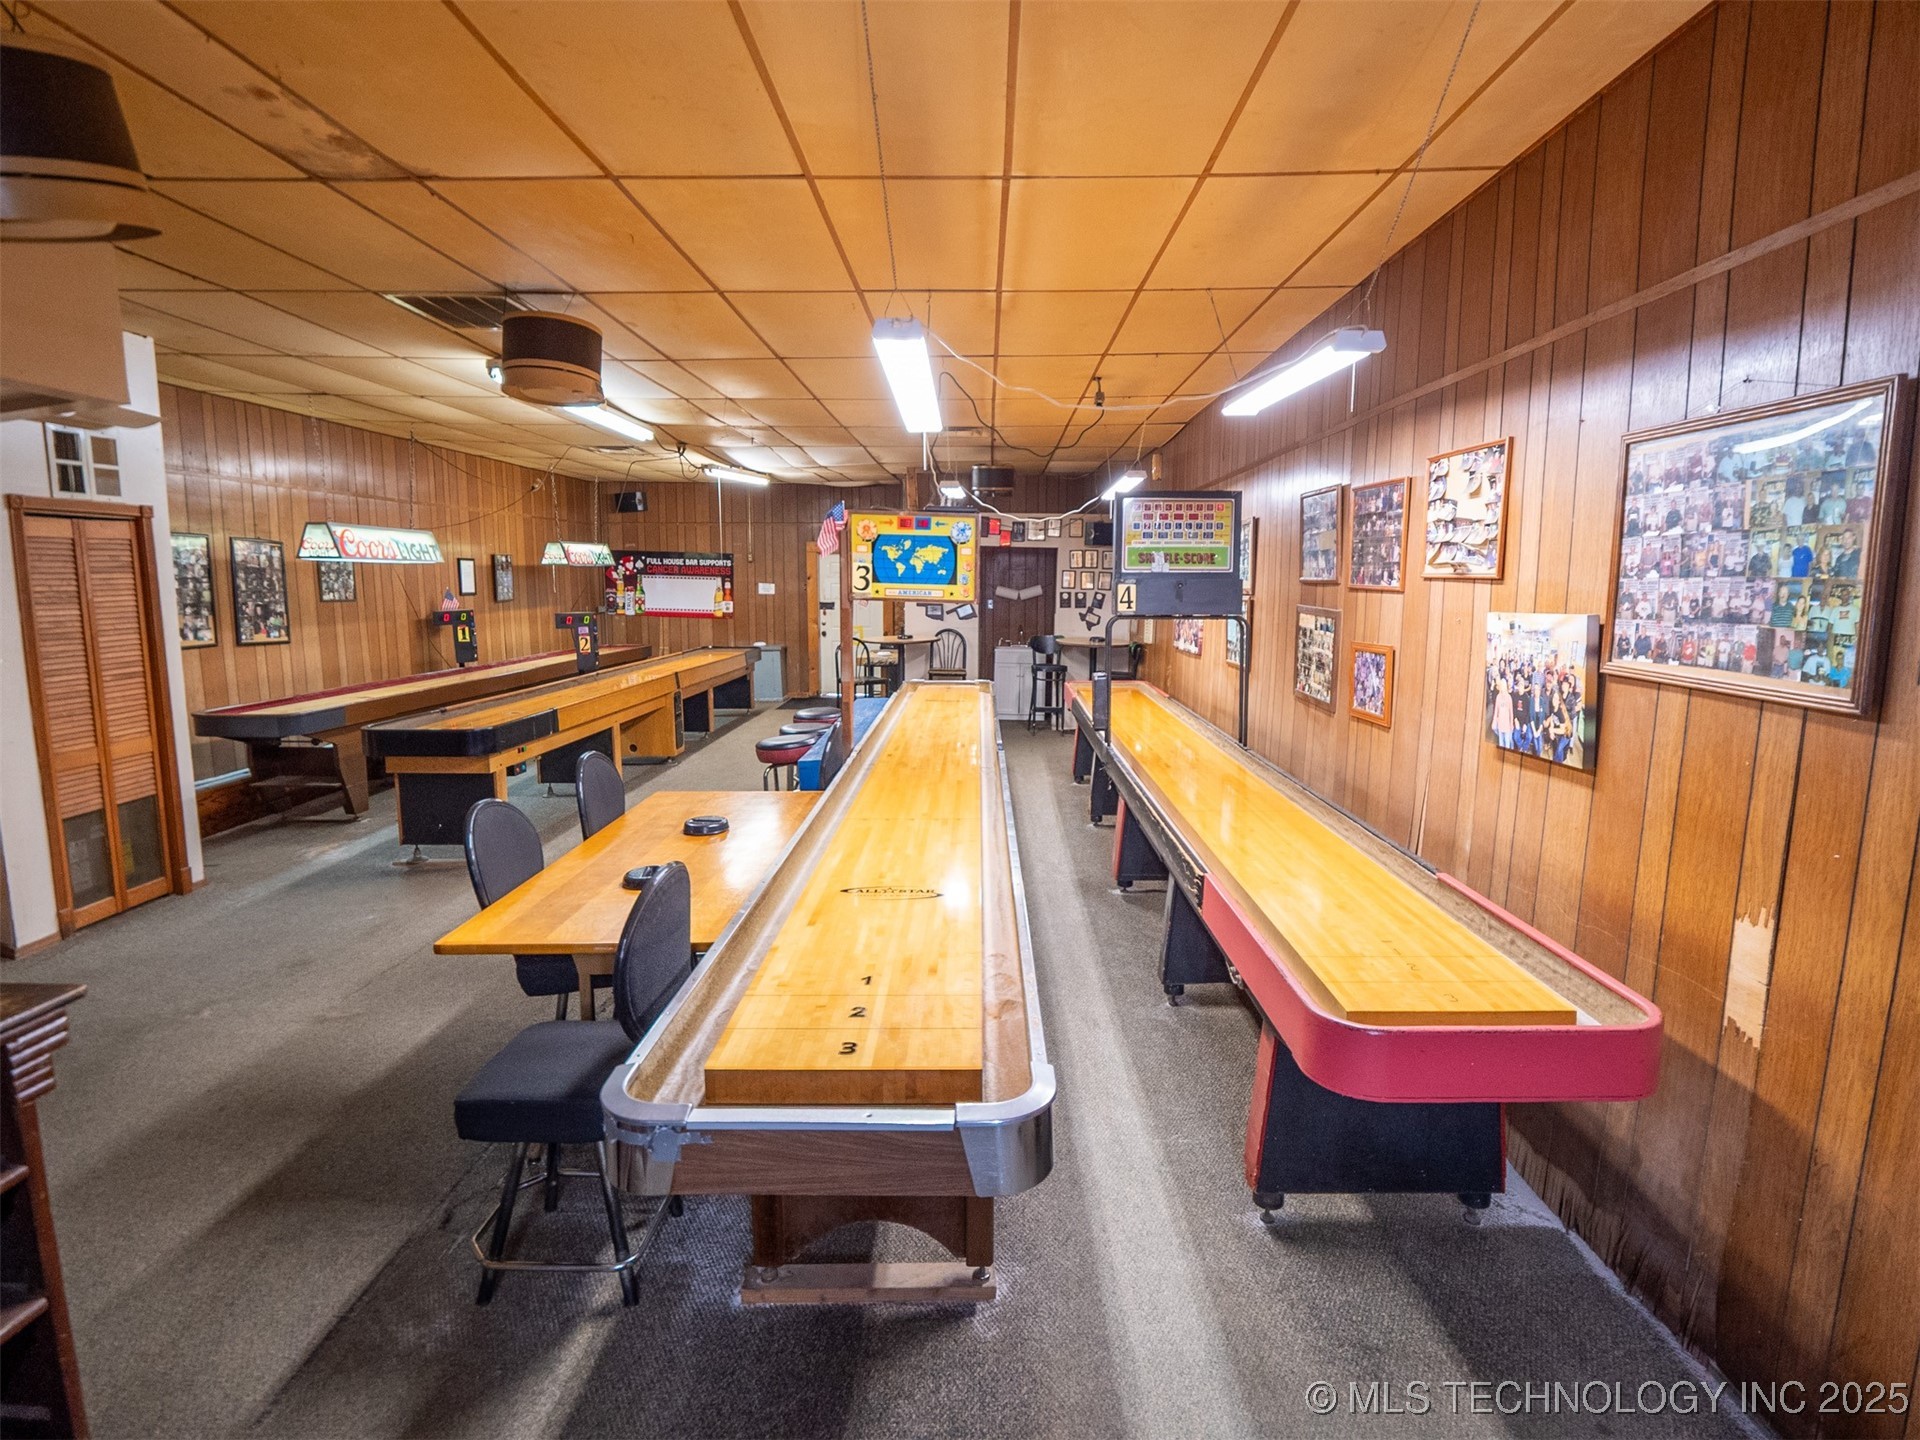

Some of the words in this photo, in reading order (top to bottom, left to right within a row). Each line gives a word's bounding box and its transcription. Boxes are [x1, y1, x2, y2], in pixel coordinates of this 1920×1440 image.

[333, 529, 398, 560] Coors
[391, 537, 438, 561] LIGHT
[646, 557, 662, 565] FULL
[685, 558, 698, 566] BAR
[699, 559, 732, 567] SUPPORTS
[1138, 552, 1216, 565] SHFLE-SCORE
[646, 565, 679, 574] CANCER
[681, 566, 732, 576] AWARENESS
[853, 565, 870, 591] 3
[1119, 585, 1134, 610] 4
[443, 613, 450, 622] 0
[460, 612, 467, 621] 0
[566, 615, 573, 625] 0
[583, 615, 590, 624] 0
[459, 626, 469, 641] 1
[580, 636, 590, 652] 2
[861, 975, 872, 985] 1
[848, 1006, 866, 1018] 2
[838, 1041, 858, 1055] 3
